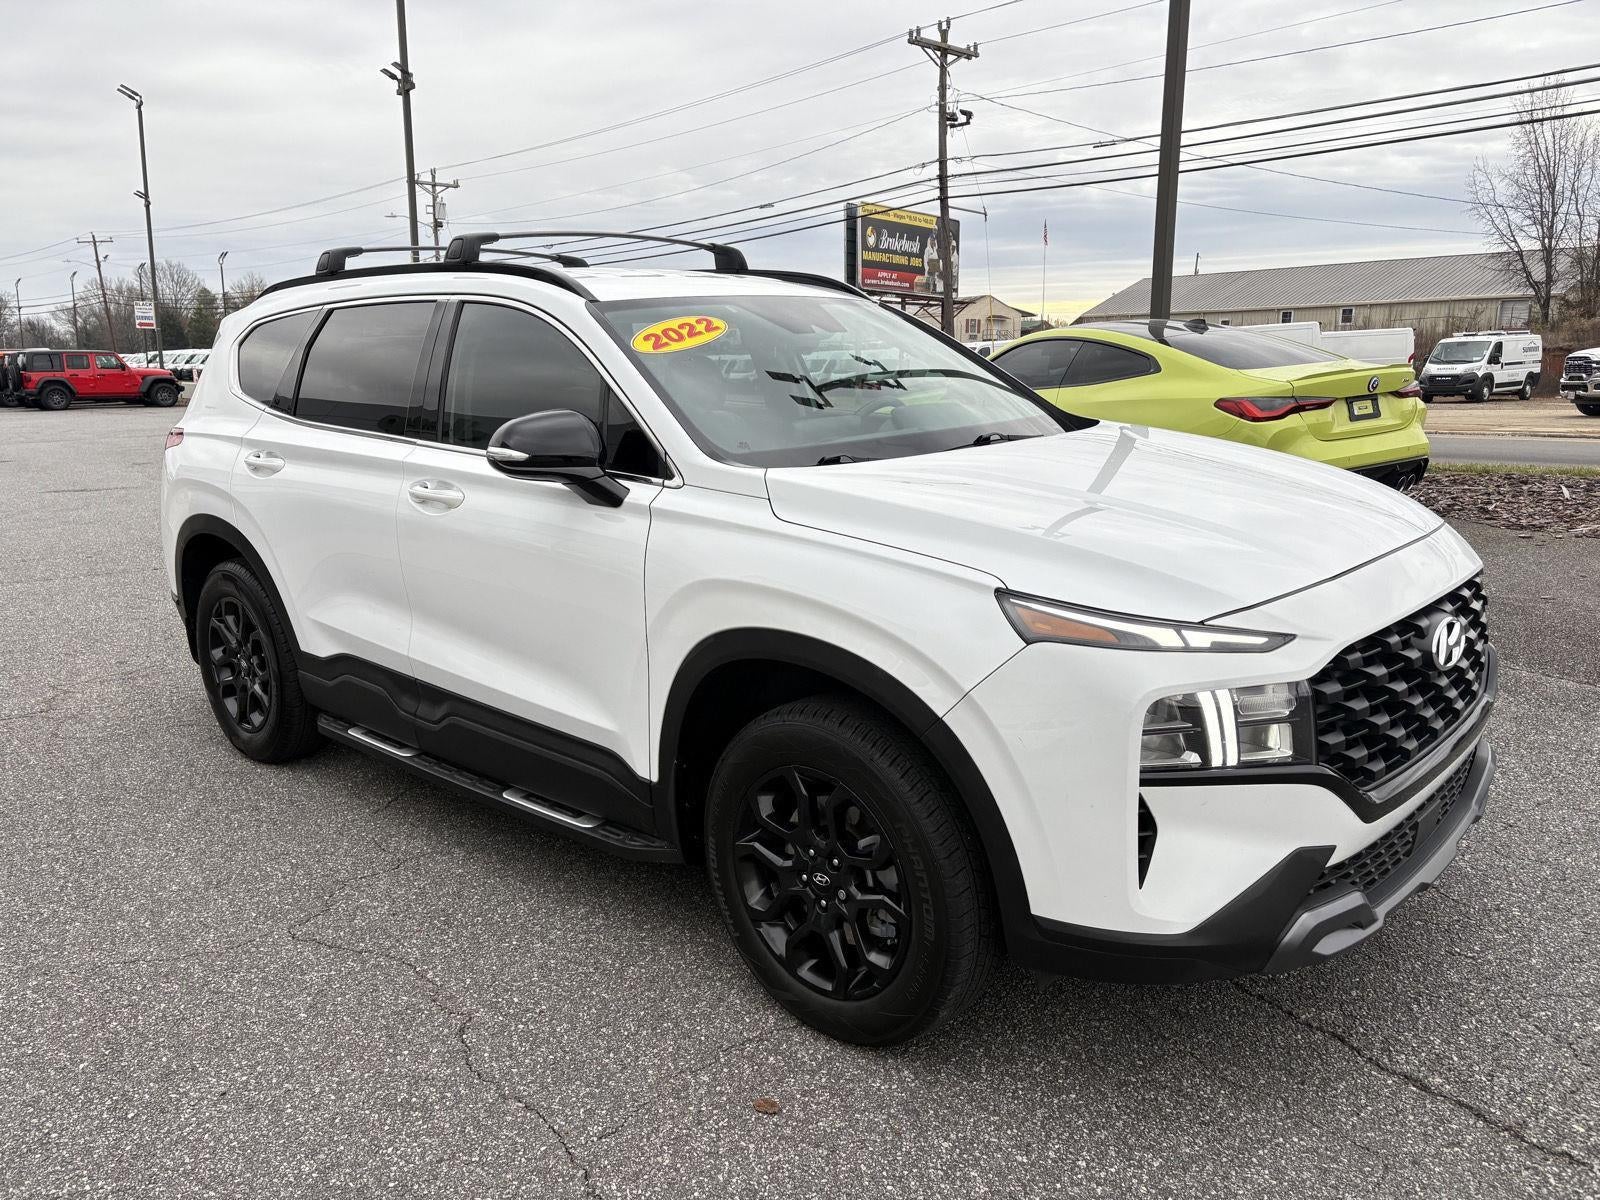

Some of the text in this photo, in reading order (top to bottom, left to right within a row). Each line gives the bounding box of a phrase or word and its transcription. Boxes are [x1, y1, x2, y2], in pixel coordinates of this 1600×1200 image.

[879, 229, 921, 254] Brakebush
[863, 250, 923, 267] MANUFACTURING JOBS
[878, 271, 891, 279] APPLY
[642, 318, 722, 351] 2022
